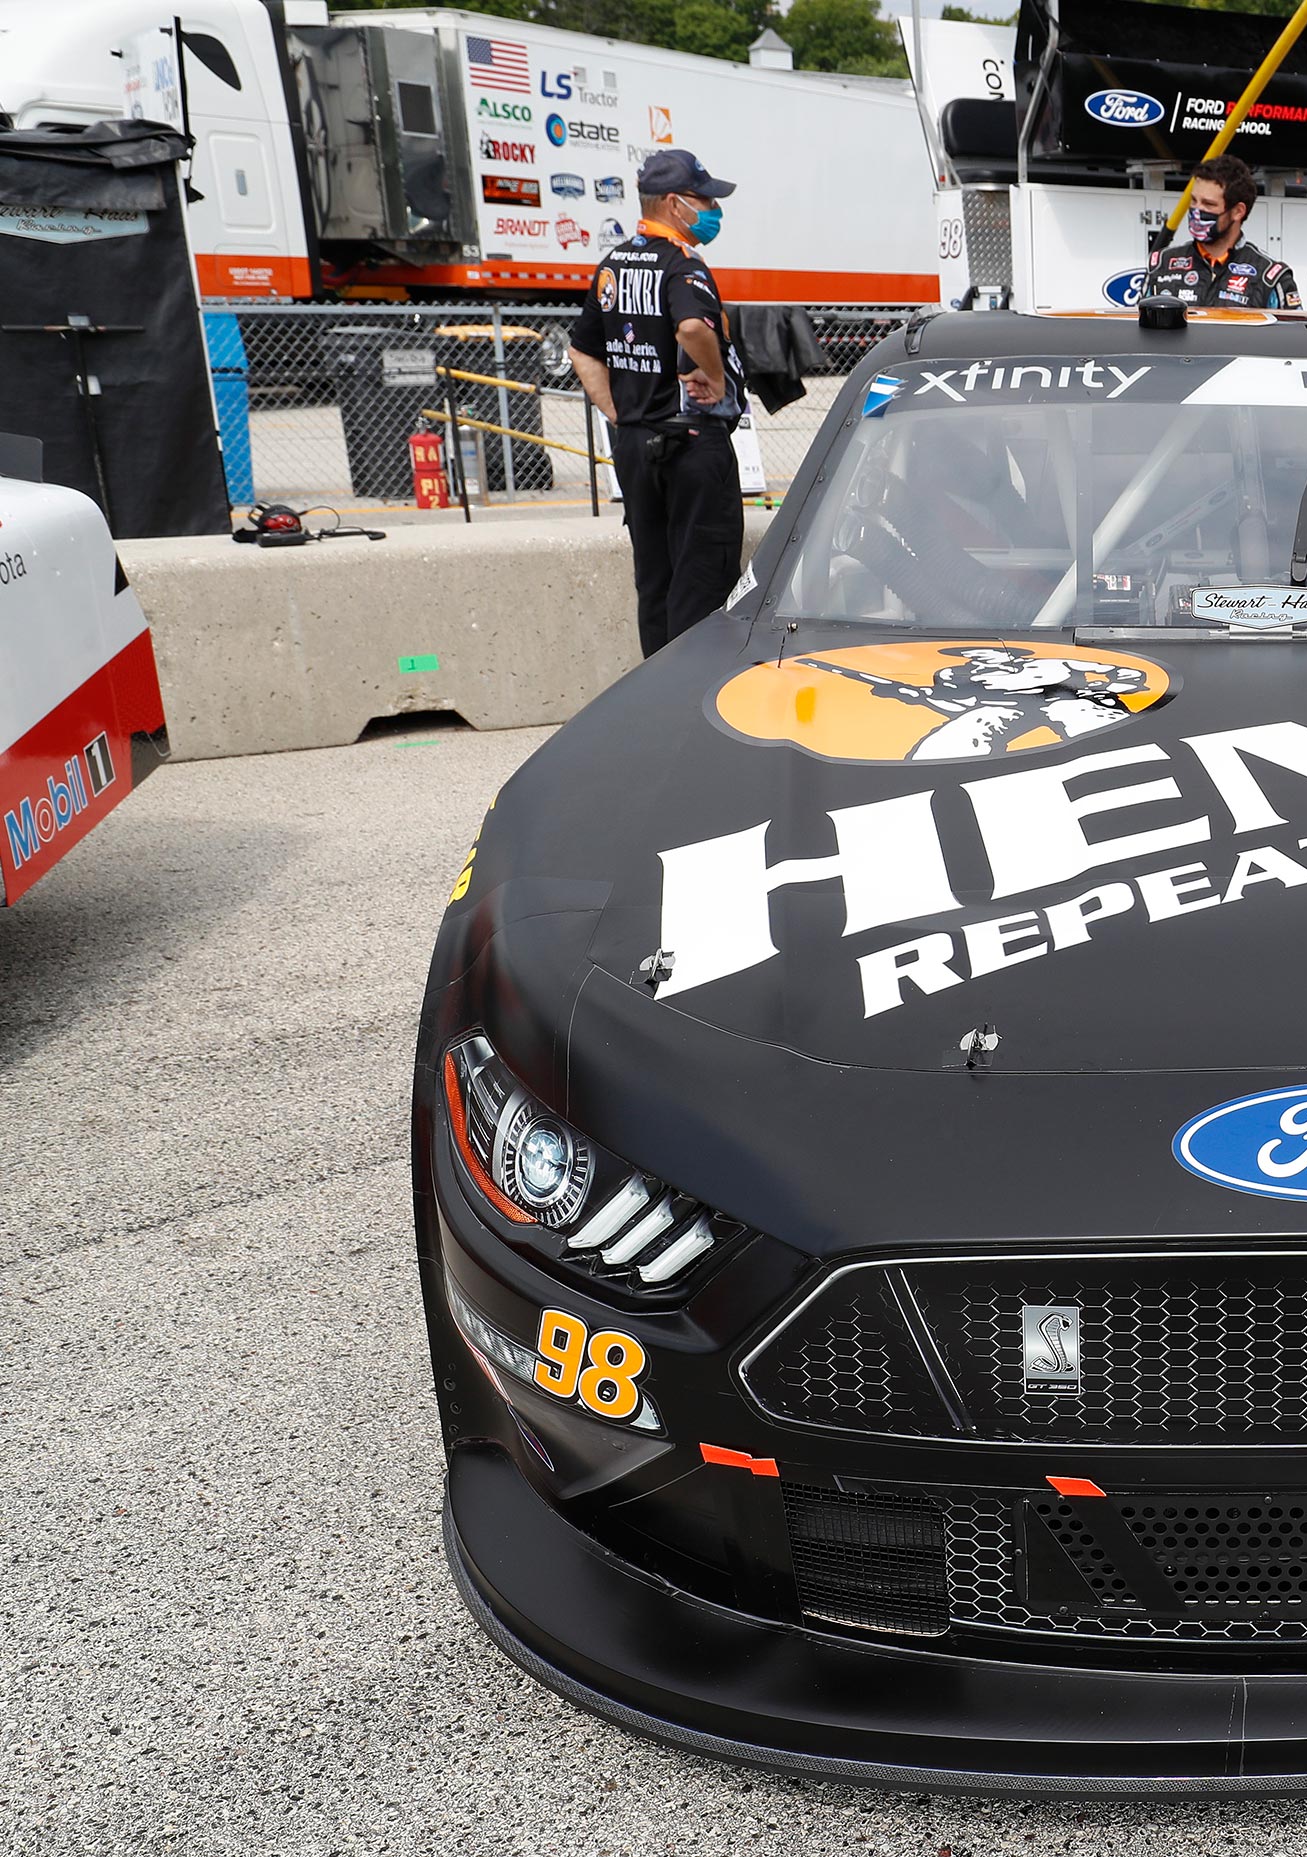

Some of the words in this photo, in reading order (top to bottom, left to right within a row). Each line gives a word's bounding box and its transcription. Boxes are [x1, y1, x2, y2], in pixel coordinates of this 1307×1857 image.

[541, 71, 572, 100] LS
[576, 87, 618, 107] Tractor
[478, 97, 532, 122] ALSCO
[1186, 98, 1225, 115] FORD
[568, 121, 620, 143] state
[1182, 117, 1226, 132] RACING
[1236, 121, 1272, 135] HOOL
[492, 140, 536, 164] ROCKY
[940, 219, 963, 259] 98
[914, 359, 1153, 401] xfinity
[1197, 593, 1272, 609] Stewart
[1230, 609, 1289, 621] Racing
[408, 658, 416, 671] 1
[4, 754, 88, 870] Mobil
[533, 1307, 646, 1419] 98
